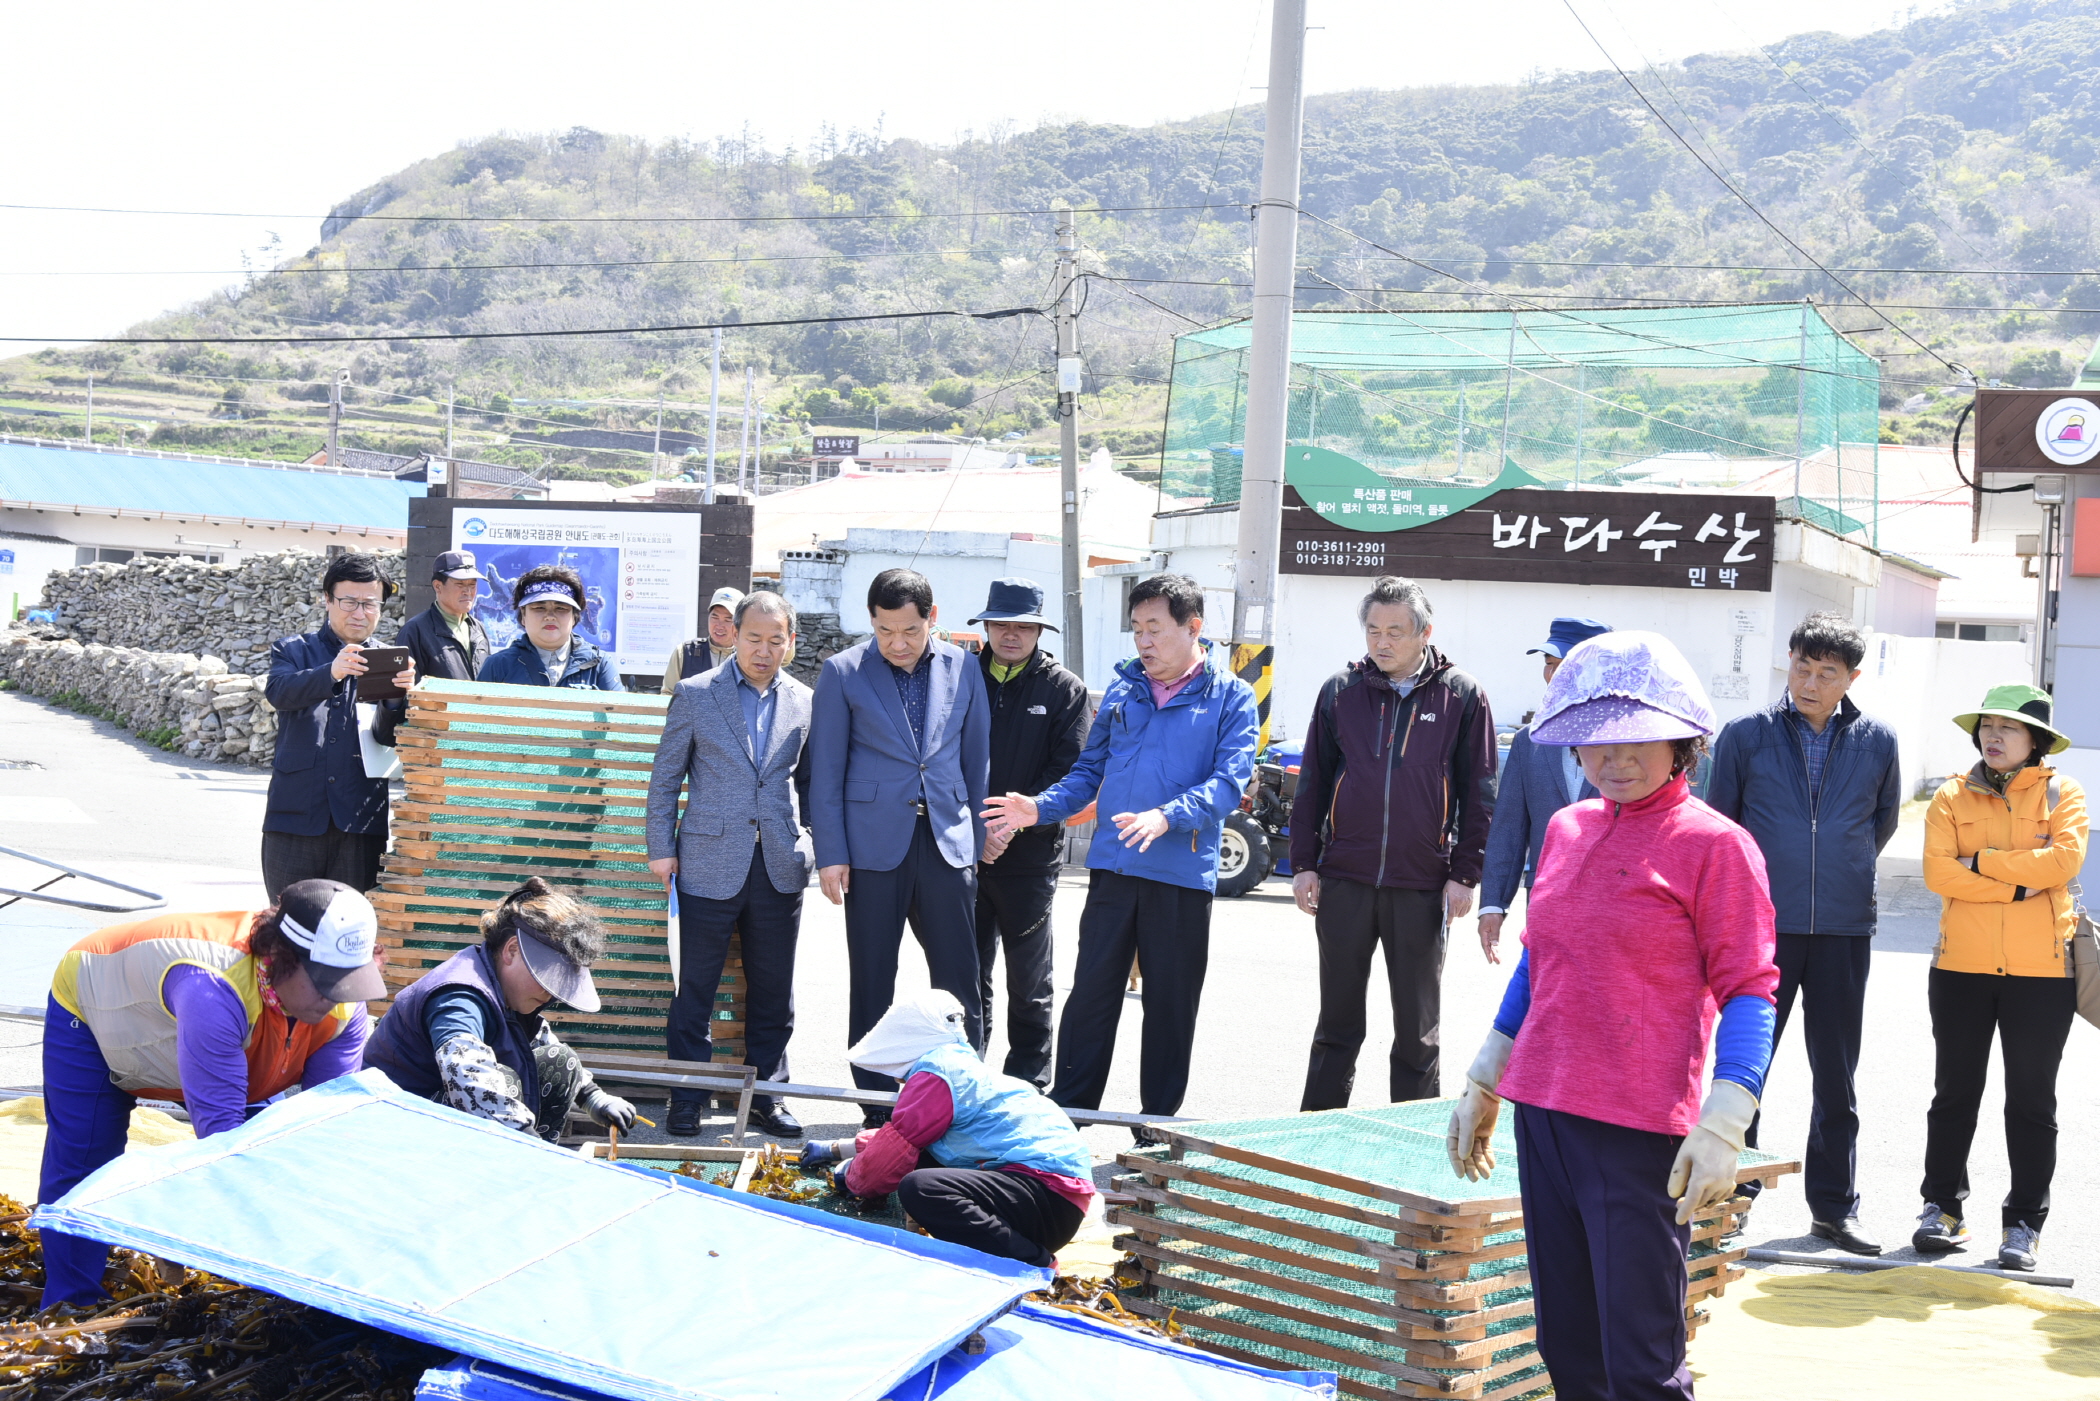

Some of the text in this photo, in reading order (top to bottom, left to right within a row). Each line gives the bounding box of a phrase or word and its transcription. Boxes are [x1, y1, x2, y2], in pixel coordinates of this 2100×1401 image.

[1353, 488, 1412, 502] 특산품 판매
[1316, 501, 1336, 514] 활어
[1341, 502, 1361, 514] 멸치
[1366, 503, 1390, 515] 액젓,
[1392, 504, 1425, 516] 돌미역,
[489, 528, 563, 541] 다도해해상국립공원
[565, 530, 590, 542] 안내도
[1492, 511, 1761, 563] 바다수산
[1296, 540, 1386, 553] 010-3611-2901
[1296, 553, 1385, 567] 010-3187-2901
